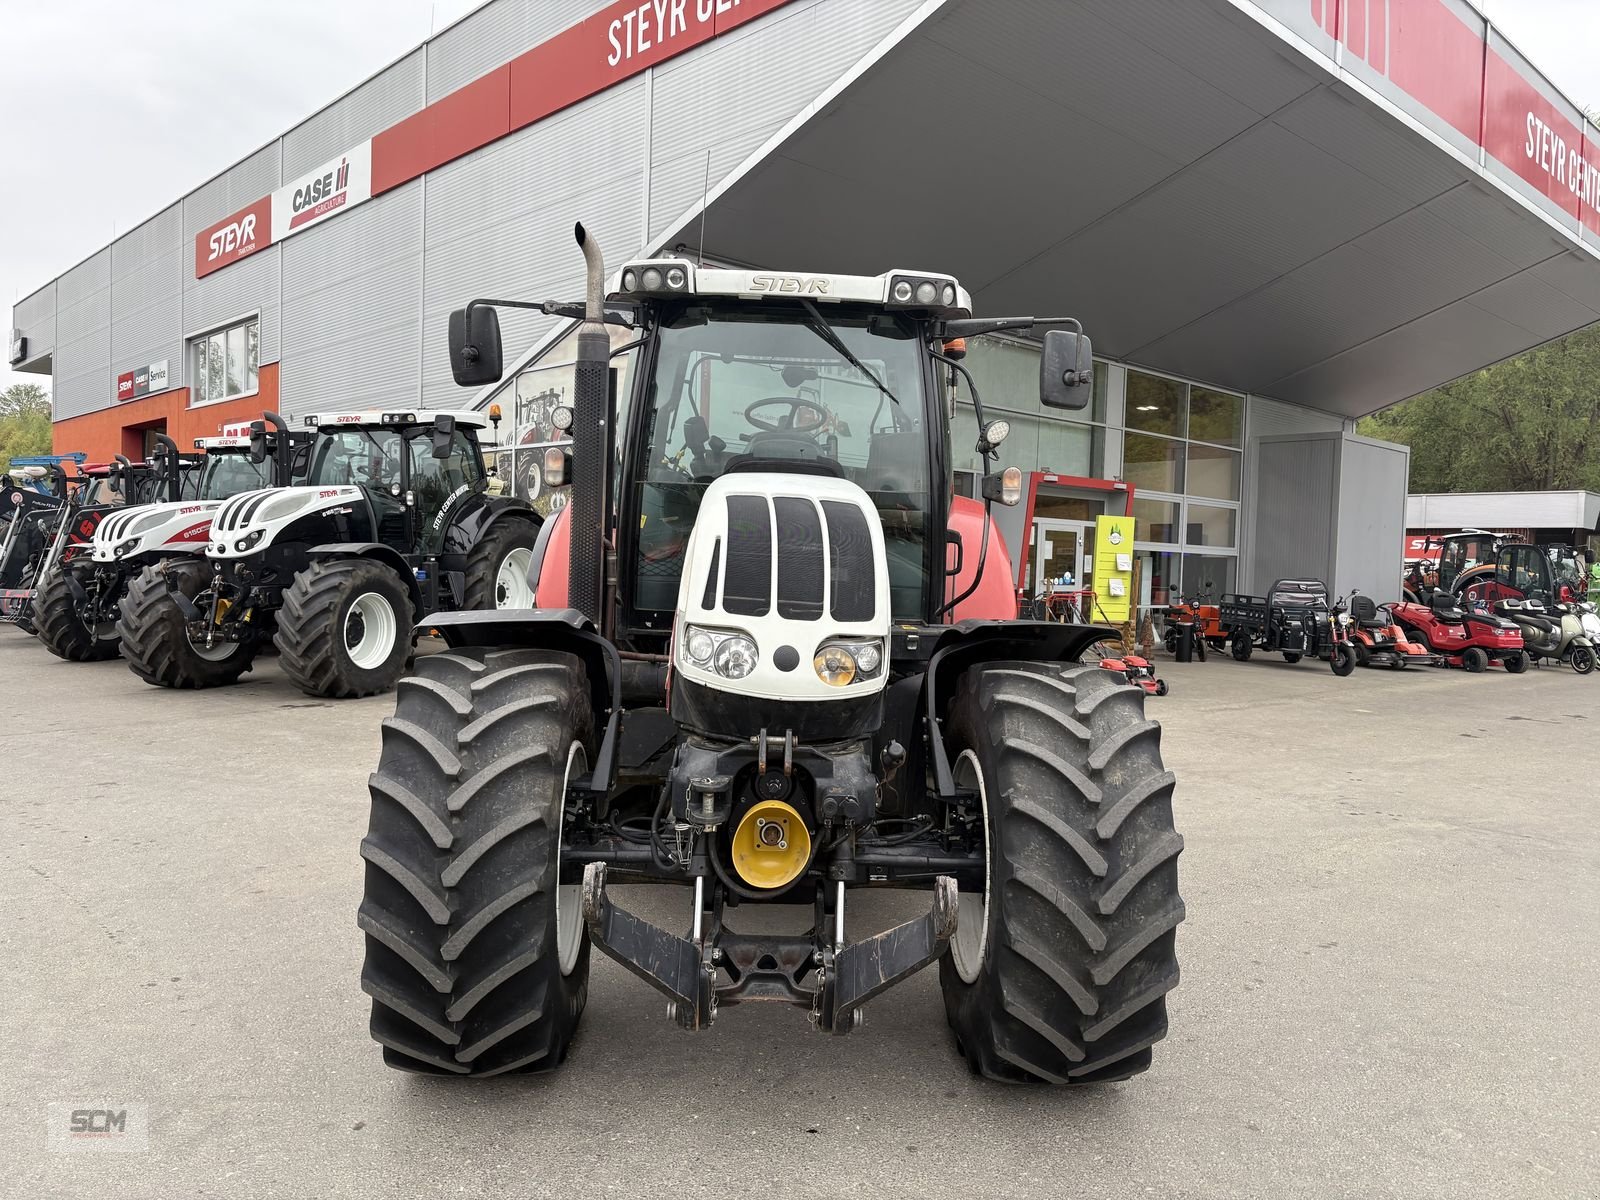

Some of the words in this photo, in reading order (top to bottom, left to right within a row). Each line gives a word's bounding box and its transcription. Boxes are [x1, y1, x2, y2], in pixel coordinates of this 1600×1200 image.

[607, 0, 687, 67] STEYR
[1525, 111, 1566, 185] STEYR
[292, 172, 333, 213] CASE
[314, 194, 346, 216] AGRICULTURE
[208, 213, 256, 261] STEYR
[749, 275, 830, 294] STEYR
[150, 370, 166, 381] Service
[336, 415, 361, 423] STEYR
[319, 490, 338, 498] STEYR
[180, 505, 202, 514] STEYR
